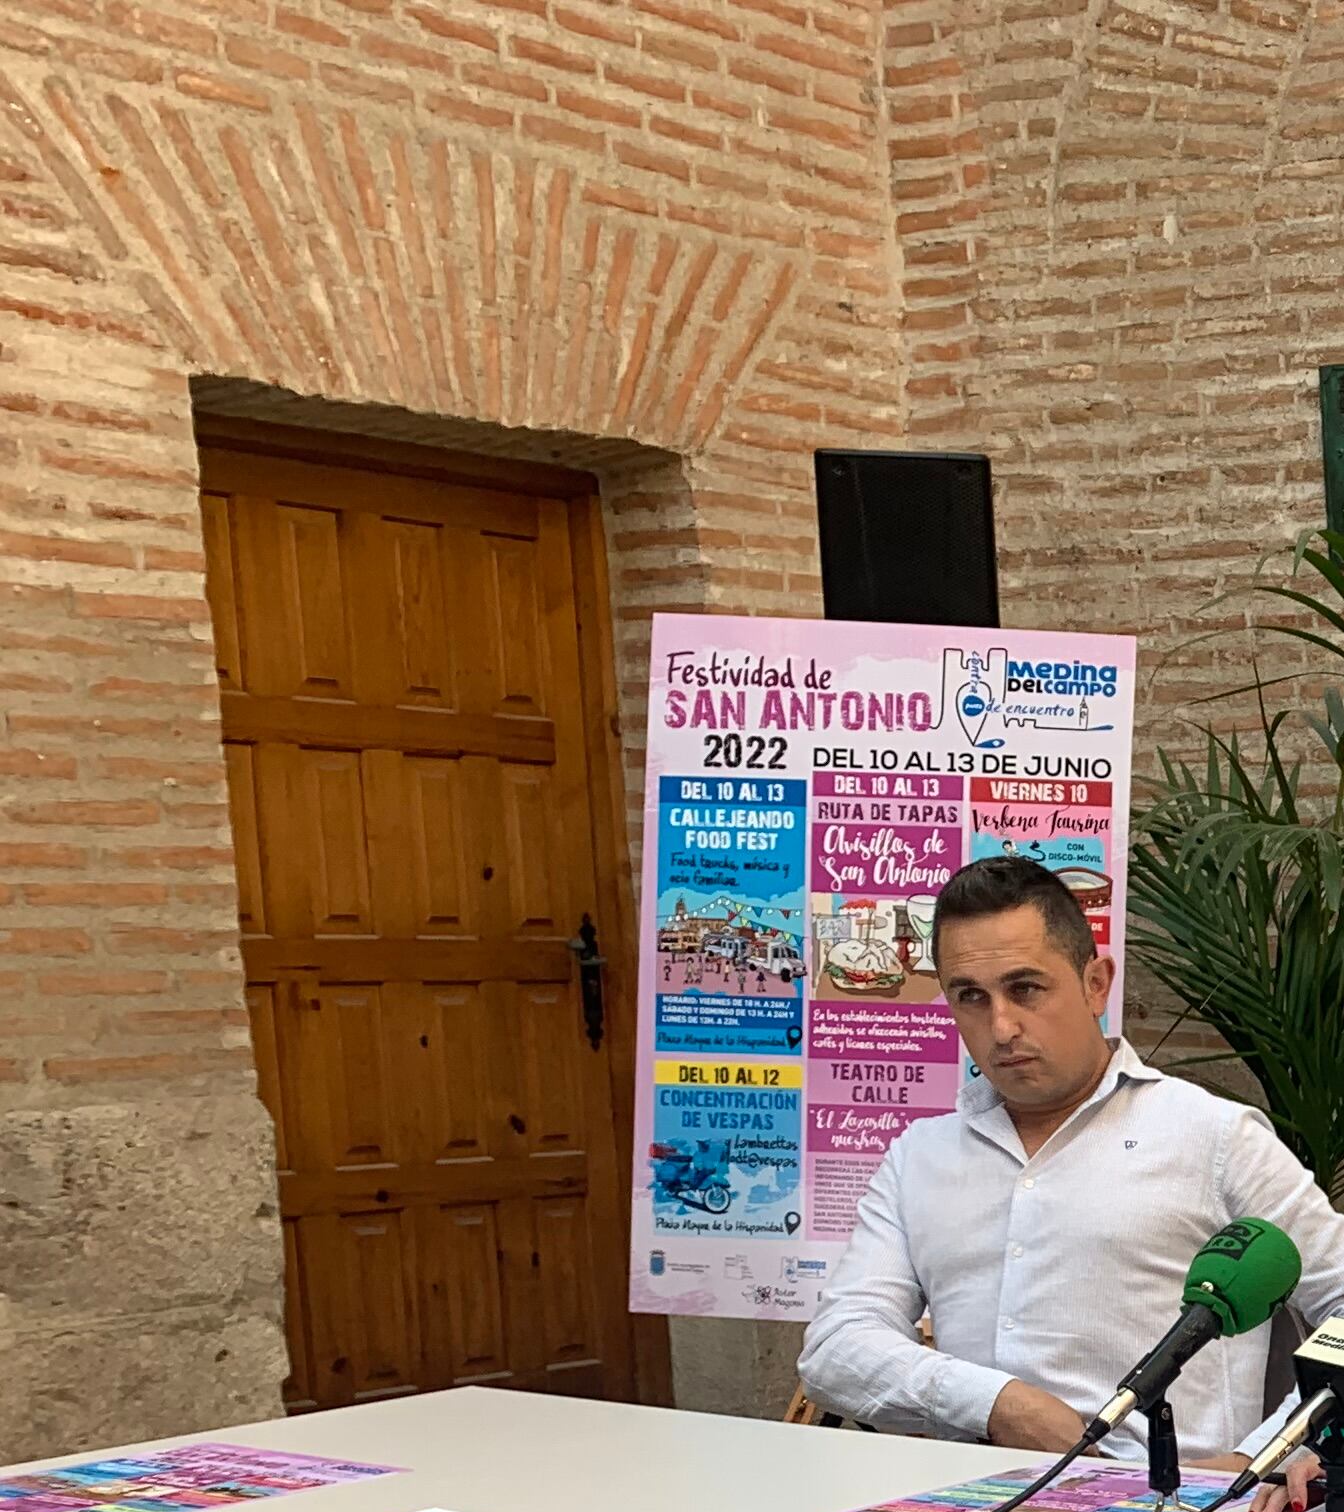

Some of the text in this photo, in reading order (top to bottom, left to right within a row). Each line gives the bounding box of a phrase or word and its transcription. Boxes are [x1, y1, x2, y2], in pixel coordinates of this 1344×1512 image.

[667, 651, 832, 690] Festividad de
[664, 690, 932, 732] SAN ANTONIO
[703, 733, 788, 770] 2022
[813, 748, 1111, 778] DEL 10 AL 13 DE JUNIO
[991, 781, 1087, 802] VIERNES 10
[670, 808, 795, 830] CALLEJEANDO
[818, 802, 958, 823] RUTA DE TAPAS
[686, 830, 778, 850] FOOD FEST
[831, 1063, 924, 1083] TEATRO DE
[660, 1089, 797, 1110] CONCENTRACIÓN
[852, 1086, 908, 1104] CALLE
[682, 1111, 774, 1130] DE VESPAS
